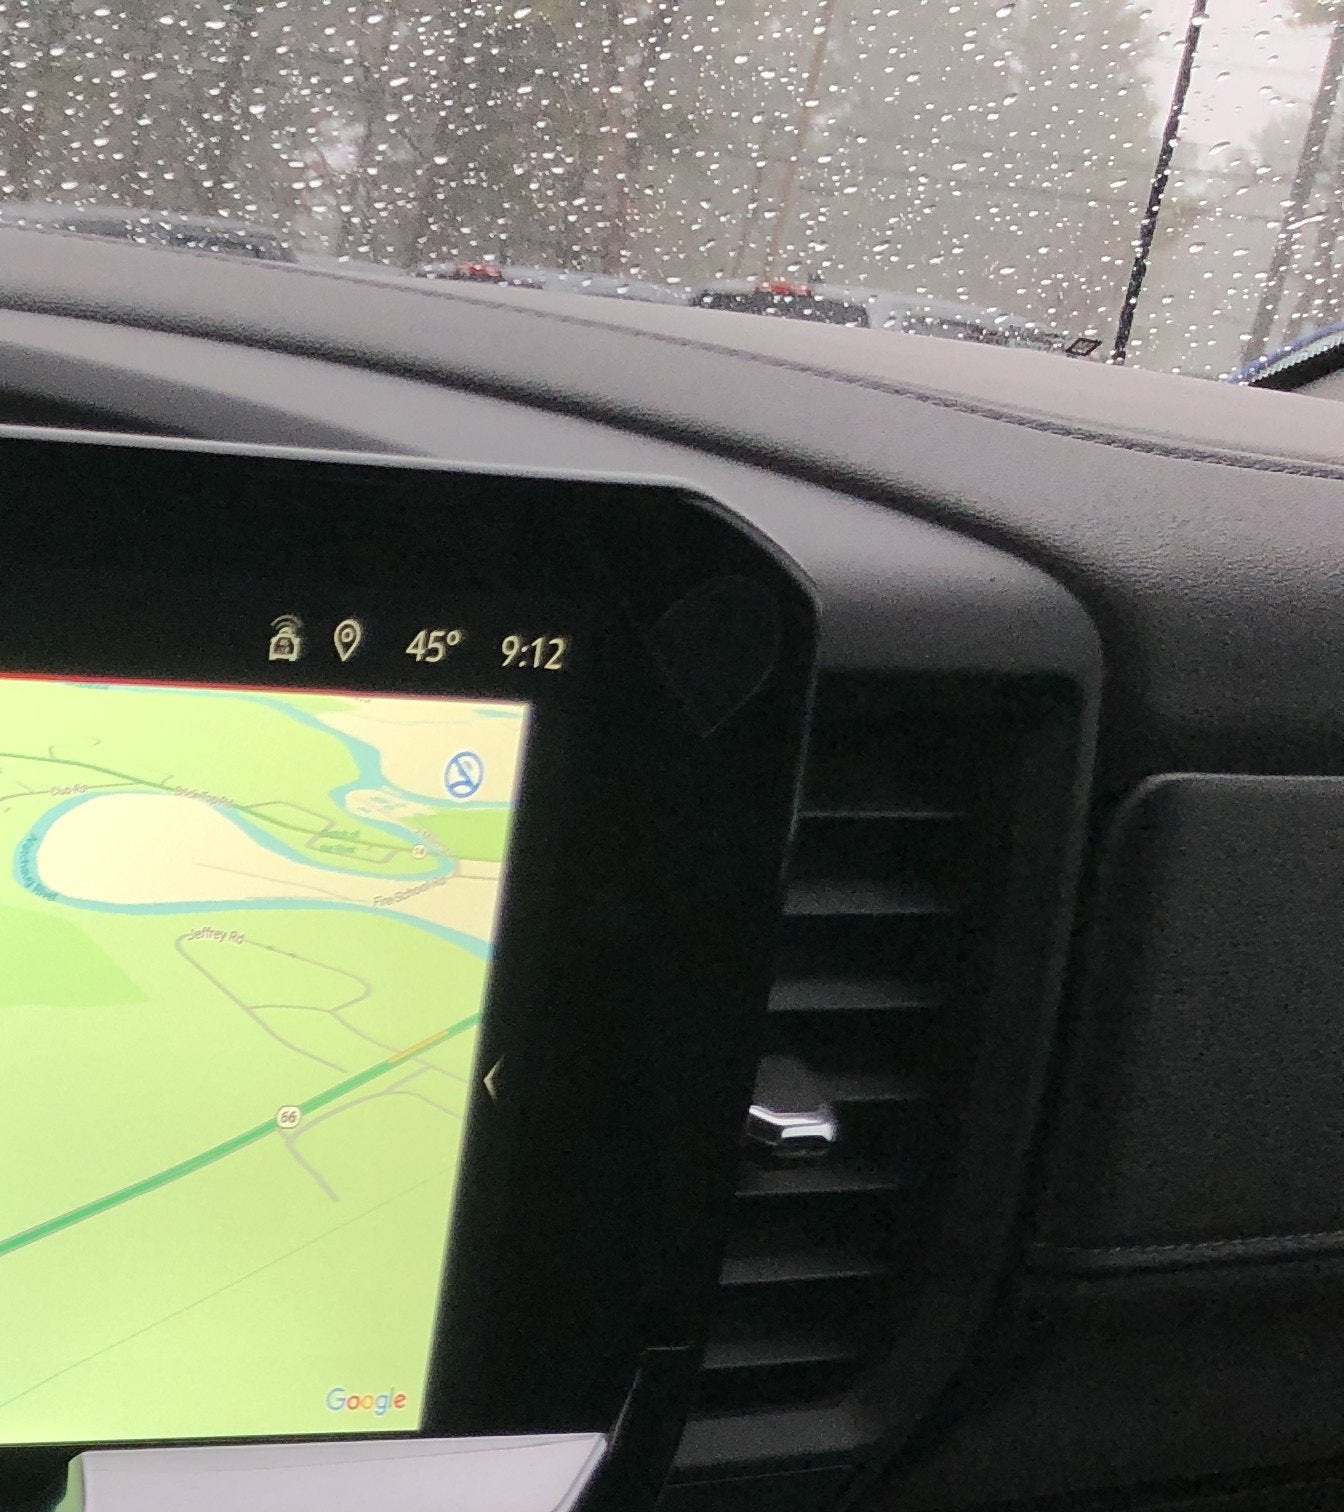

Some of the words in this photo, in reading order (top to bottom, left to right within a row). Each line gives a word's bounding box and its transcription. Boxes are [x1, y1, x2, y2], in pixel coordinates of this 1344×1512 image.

[406, 628, 462, 664] 45°
[500, 635, 569, 671] 9:12
[187, 926, 226, 943] Jeffrey
[228, 930, 246, 945] Rd
[279, 1109, 299, 1126] 66
[326, 1386, 408, 1417] Google
